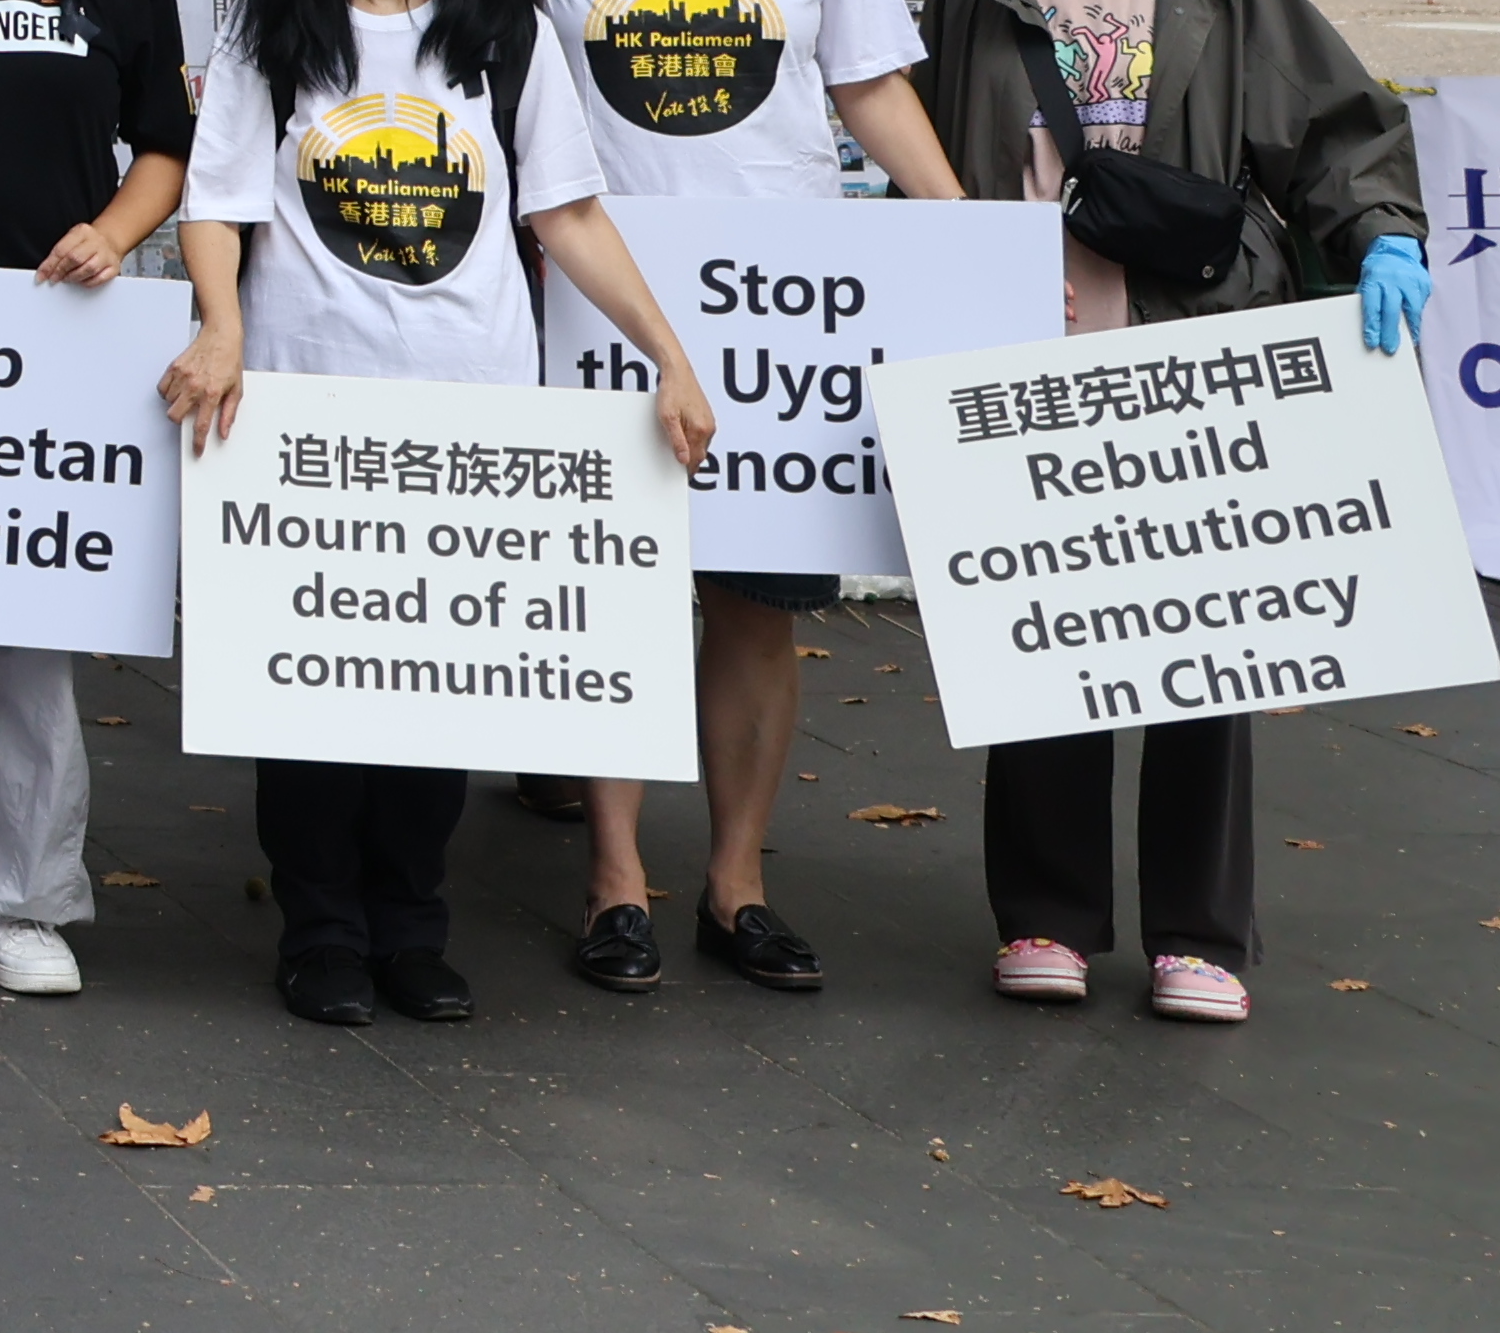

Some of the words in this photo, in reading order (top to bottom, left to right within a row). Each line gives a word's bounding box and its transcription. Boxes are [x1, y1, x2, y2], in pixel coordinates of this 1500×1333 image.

[614, 32, 643, 48] HK
[650, 31, 753, 48] Parliament
[630, 53, 737, 78] 香港議會
[322, 177, 349, 194] HK
[356, 178, 460, 199] Parliament
[338, 200, 446, 229] 香港議會
[698, 256, 866, 334] Stop
[576, 343, 662, 393] th
[947, 336, 1334, 445] 重建宪政中国
[278, 433, 614, 503] 追悼各族死难
[1025, 420, 1270, 502] Rebuild
[220, 499, 406, 555] Mourn
[426, 524, 551, 564] over
[568, 518, 660, 568] the
[946, 479, 1392, 588] constitutional
[291, 572, 428, 624] dead
[448, 580, 507, 628] of
[524, 585, 588, 632] all
[1008, 573, 1361, 655] democracy
[266, 649, 634, 704] communities
[1079, 670, 1141, 722] in
[1160, 647, 1347, 720] China
